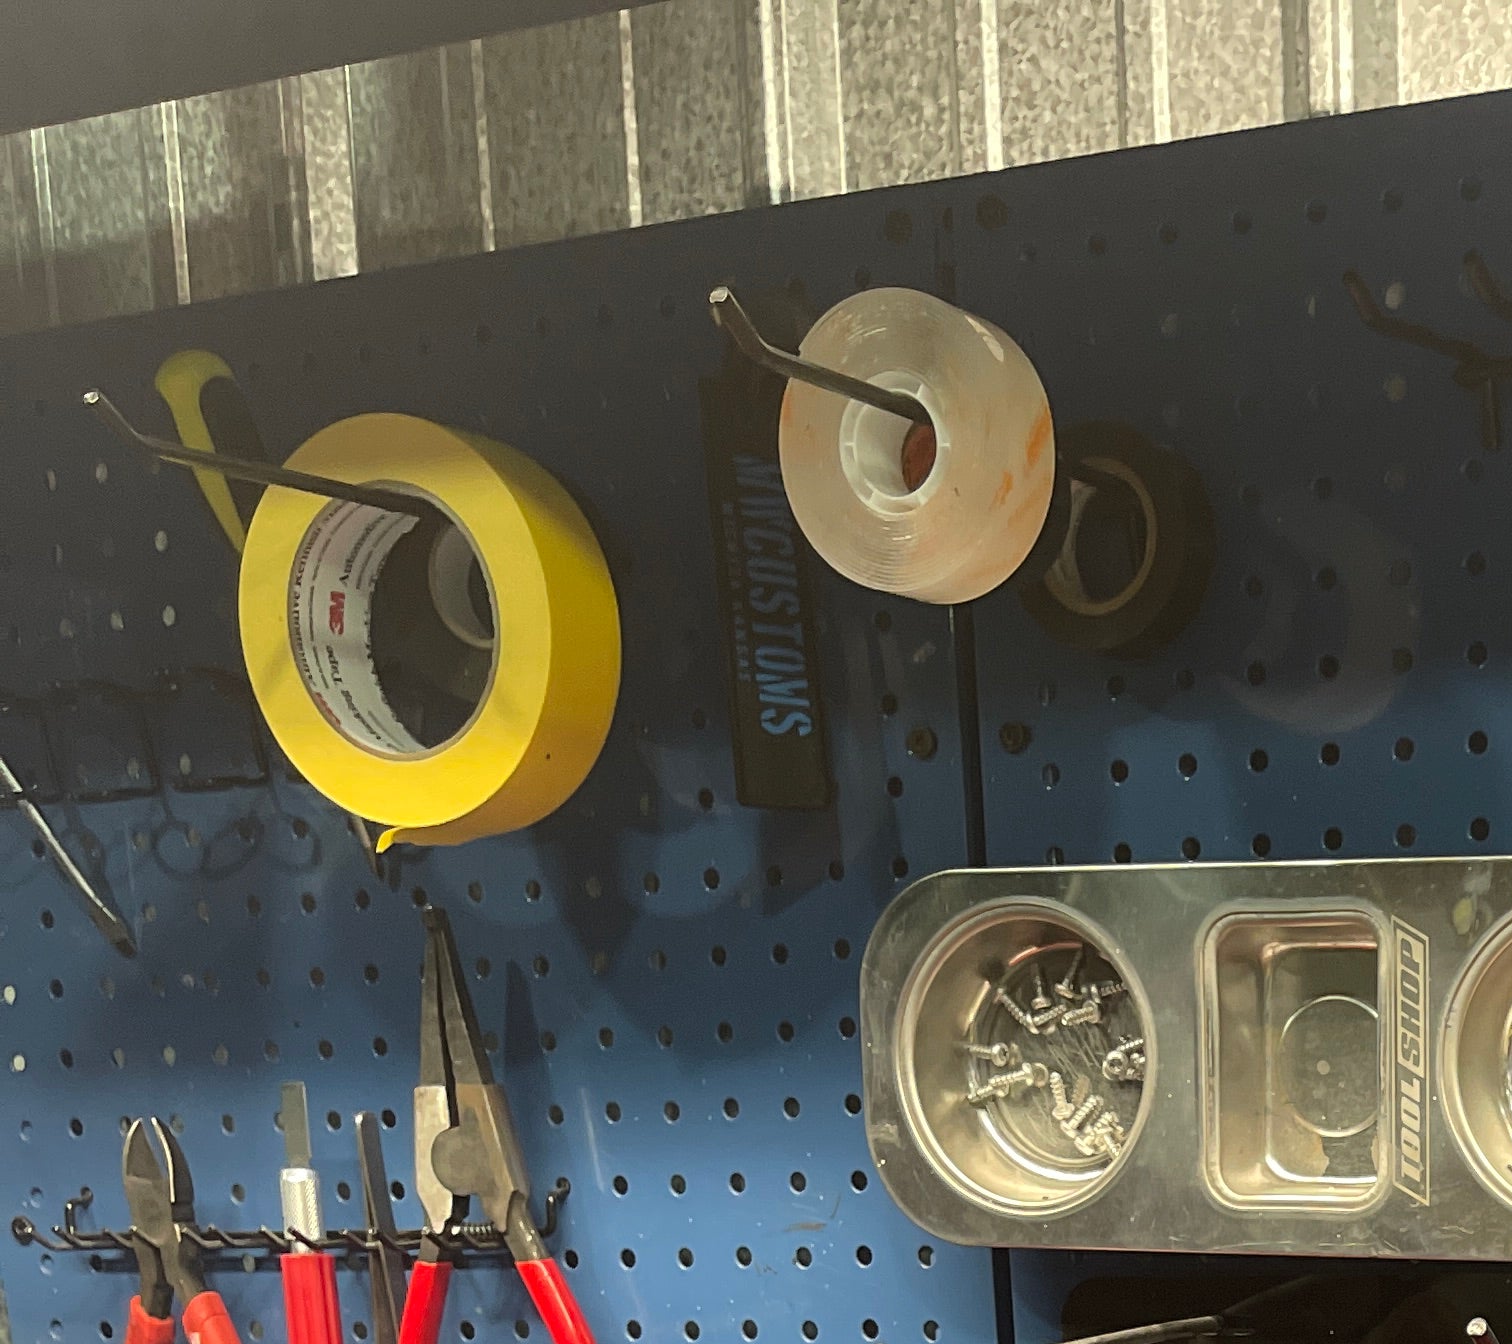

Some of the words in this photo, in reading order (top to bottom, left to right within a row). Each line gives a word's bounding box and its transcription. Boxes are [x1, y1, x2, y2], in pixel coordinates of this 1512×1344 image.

[329, 591, 346, 636] 3M
[733, 456, 812, 737] MWCUSTOMS
[325, 645, 343, 686] Tape
[1400, 937, 1421, 1069] SHOP
[1400, 1077, 1421, 1182] TOOL
